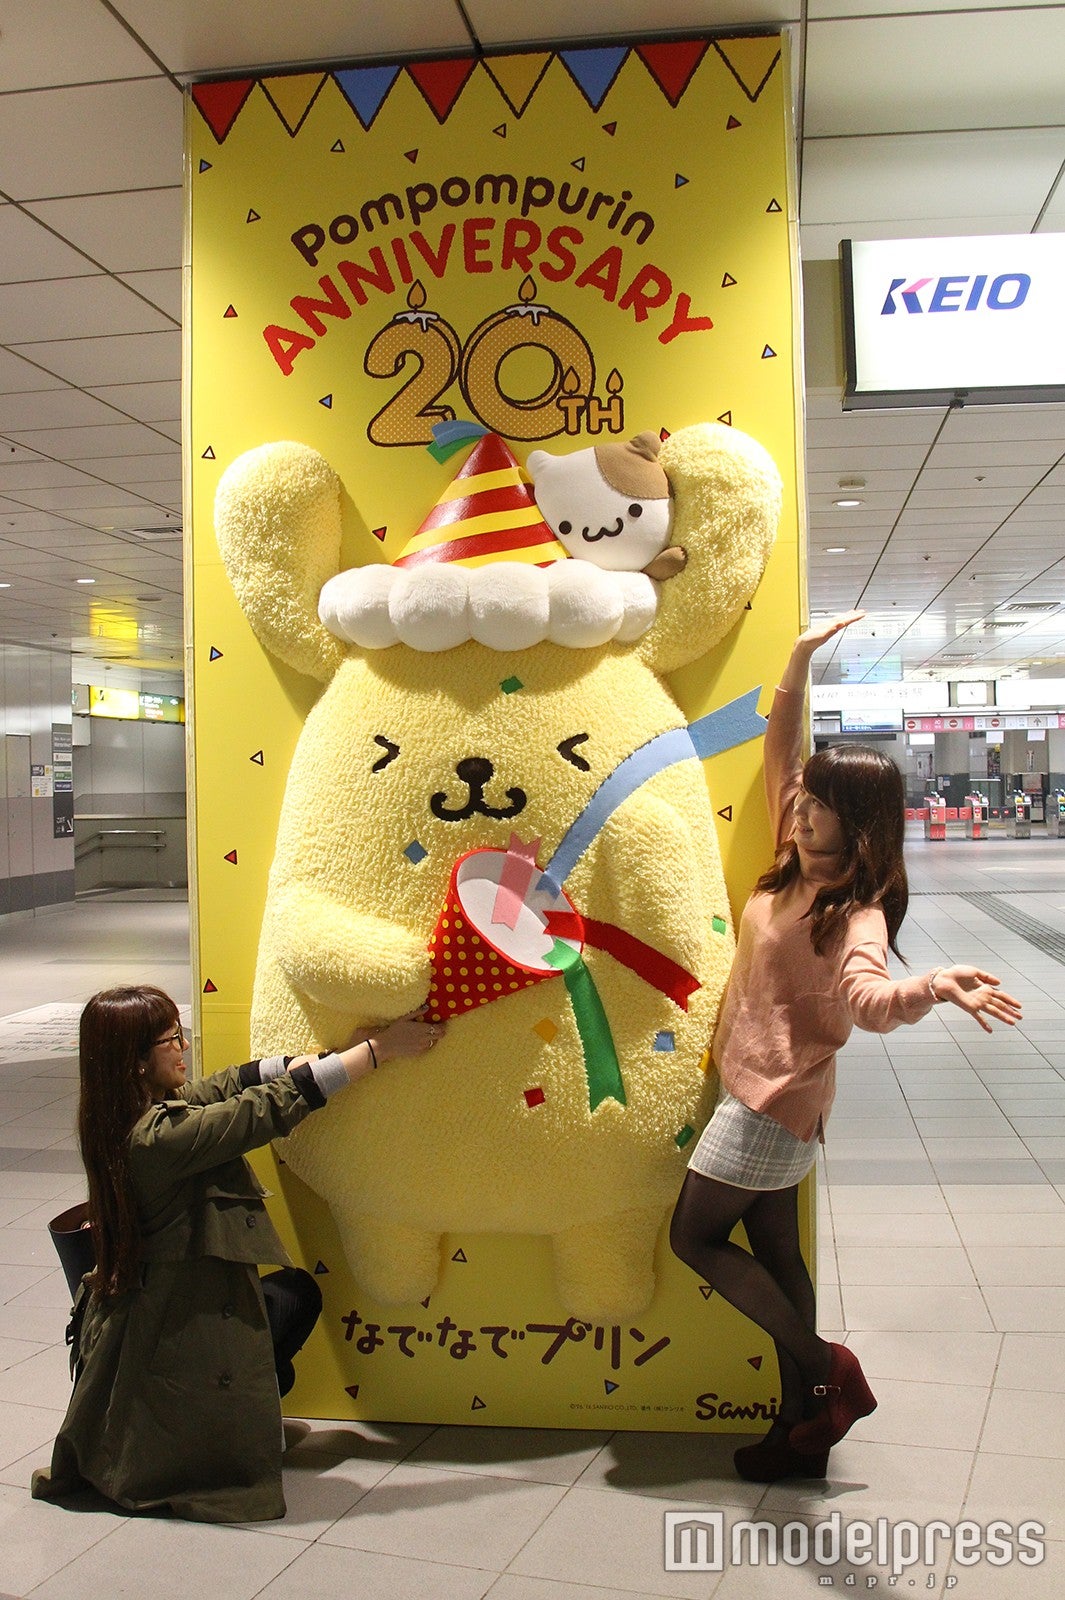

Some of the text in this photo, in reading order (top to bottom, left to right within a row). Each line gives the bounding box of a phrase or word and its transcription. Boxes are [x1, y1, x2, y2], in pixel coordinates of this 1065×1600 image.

[291, 173, 655, 267] Pompompurin
[262, 216, 714, 377] ANNIVERSARY
[880, 272, 1032, 316] KEIO
[341, 1310, 671, 1370] なでなでプリン
[695, 1393, 782, 1421] Sanri
